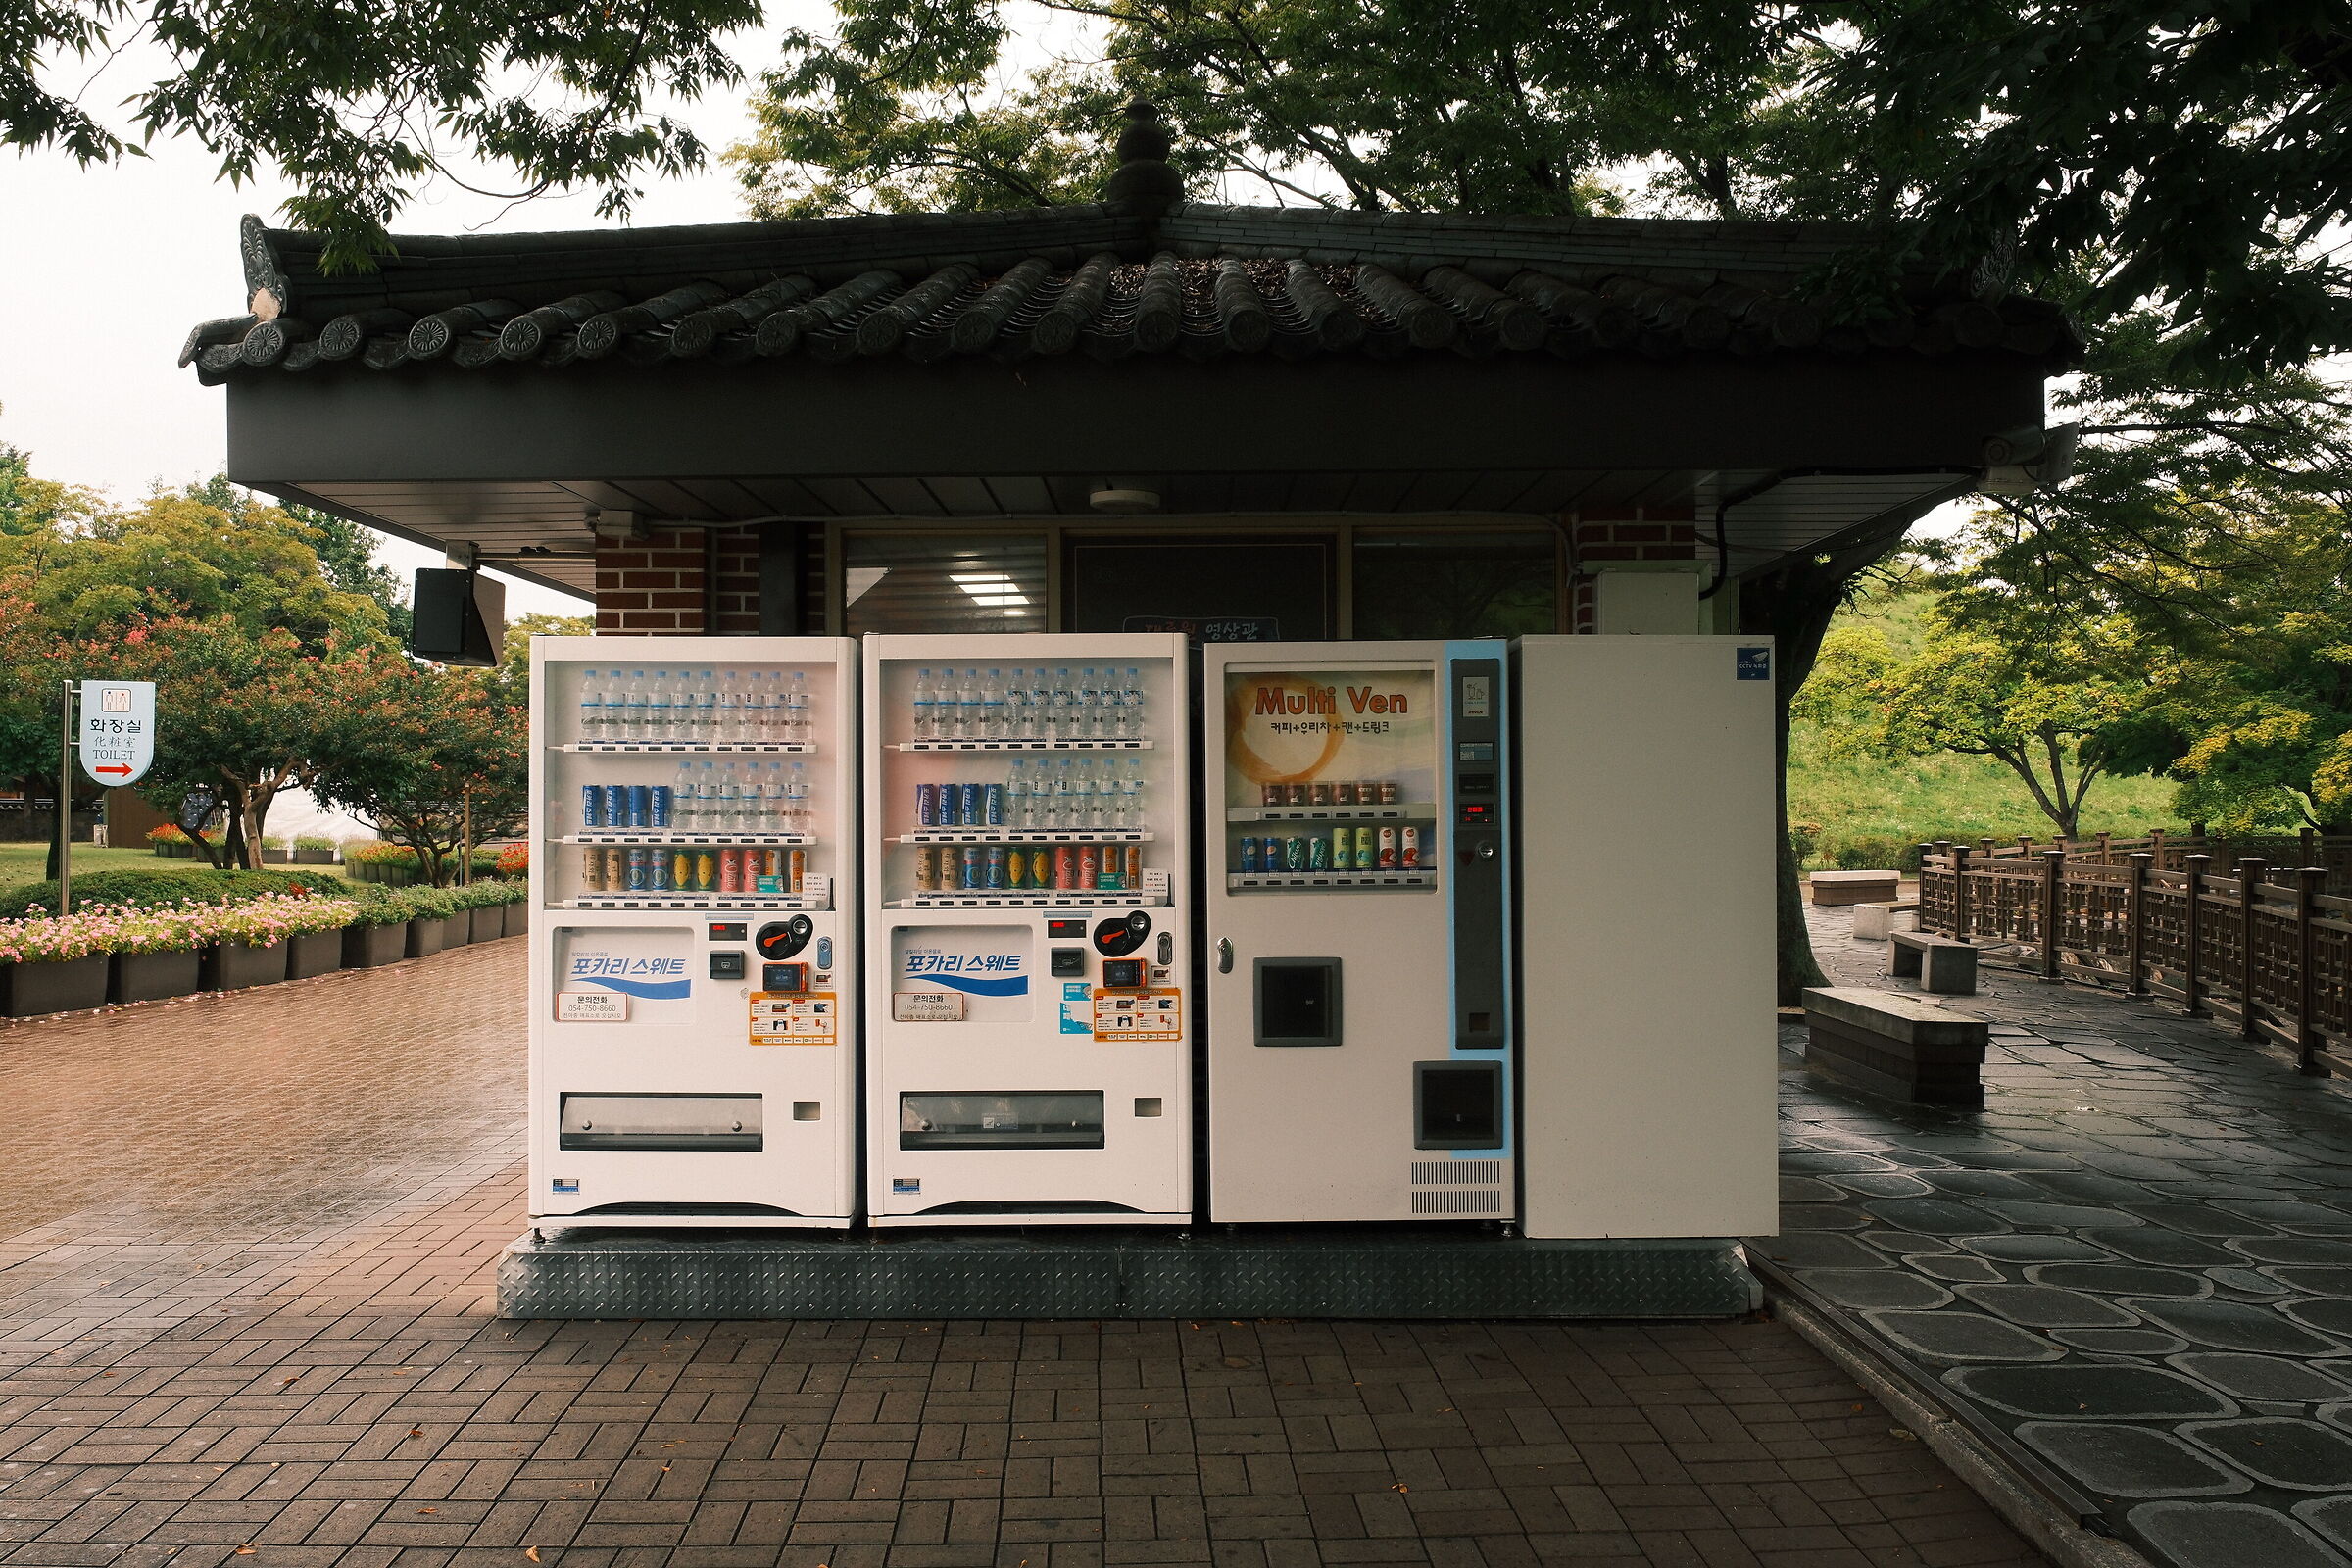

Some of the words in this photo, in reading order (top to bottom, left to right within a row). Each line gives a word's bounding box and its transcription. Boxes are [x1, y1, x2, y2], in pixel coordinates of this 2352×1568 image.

[1205, 621, 1259, 641] 영상관
[1255, 686, 1337, 715] Multi
[1347, 686, 1408, 714] Ven
[90, 718, 141, 734] 화장실
[93, 749, 135, 760] TOILET
